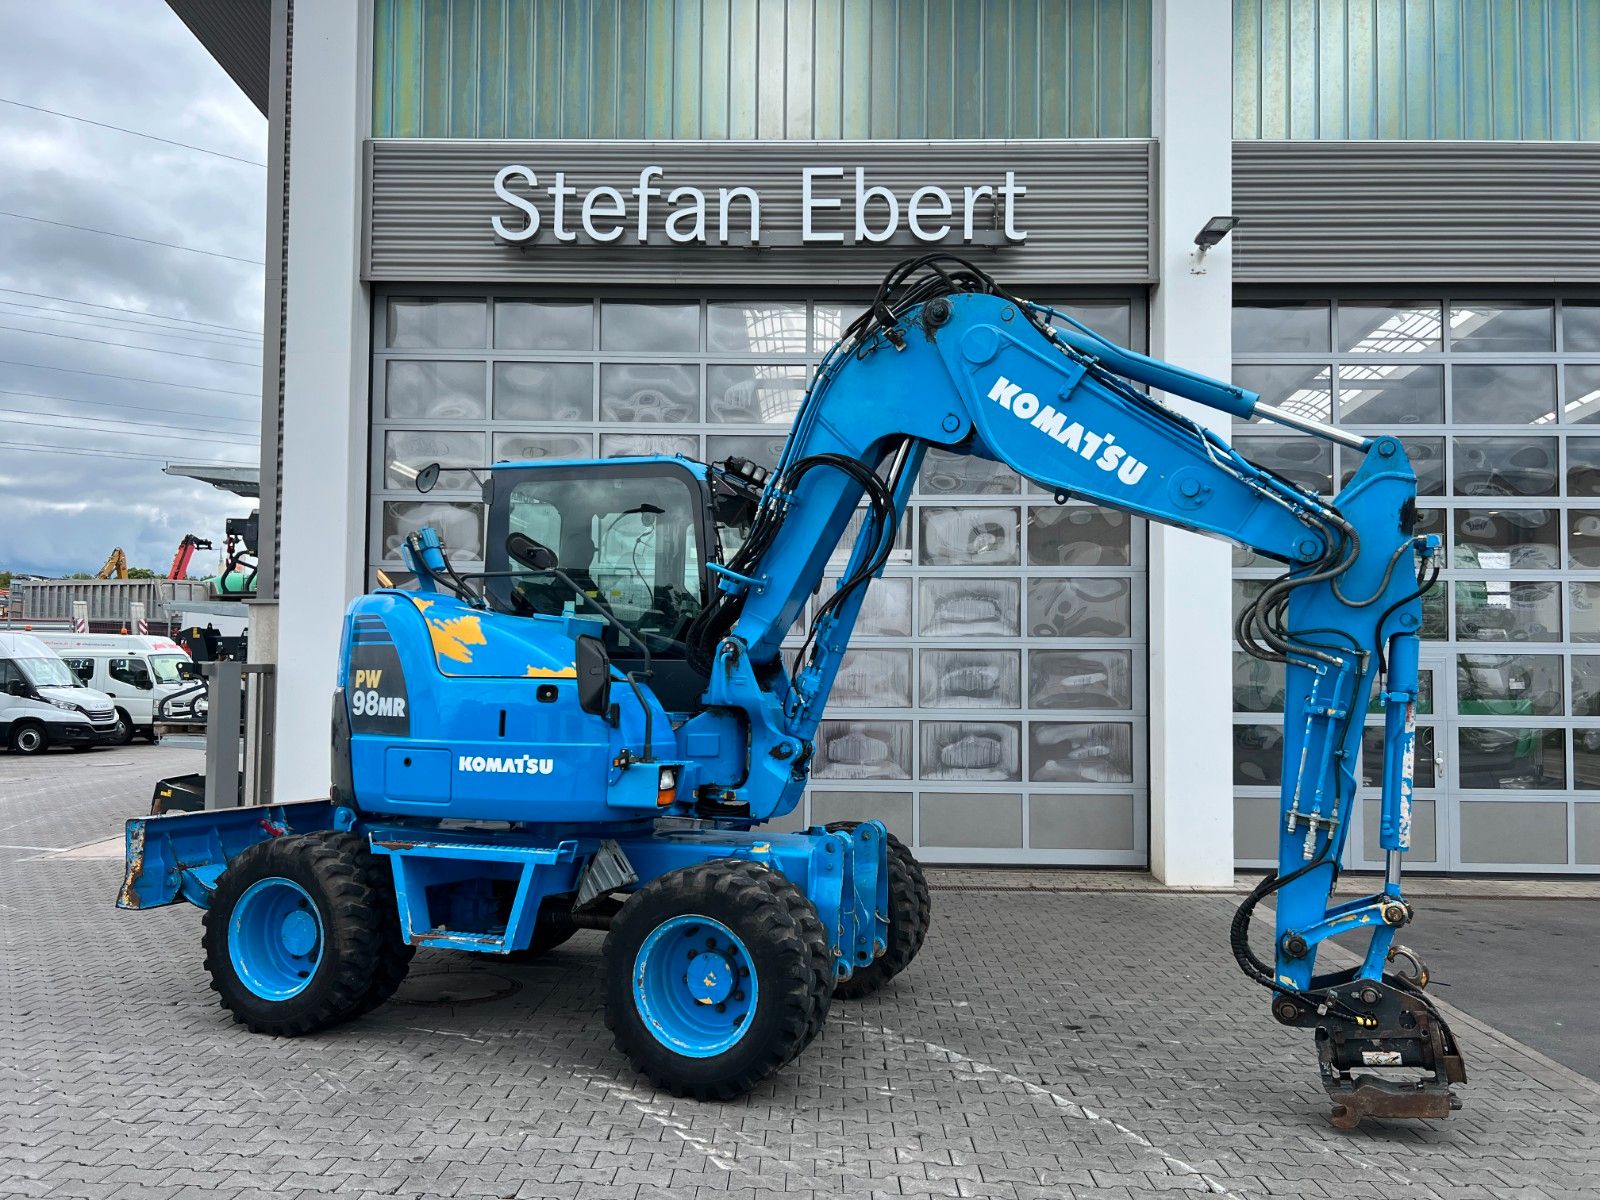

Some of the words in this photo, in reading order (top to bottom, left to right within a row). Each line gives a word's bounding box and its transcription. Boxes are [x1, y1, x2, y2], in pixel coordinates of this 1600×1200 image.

[491, 164, 760, 243] Stefan
[802, 166, 1027, 243] Ebert
[987, 376, 1149, 486] KOMATSU
[354, 670, 382, 689] PW
[352, 690, 405, 718] 98MR
[459, 754, 554, 775] KOMATSU
